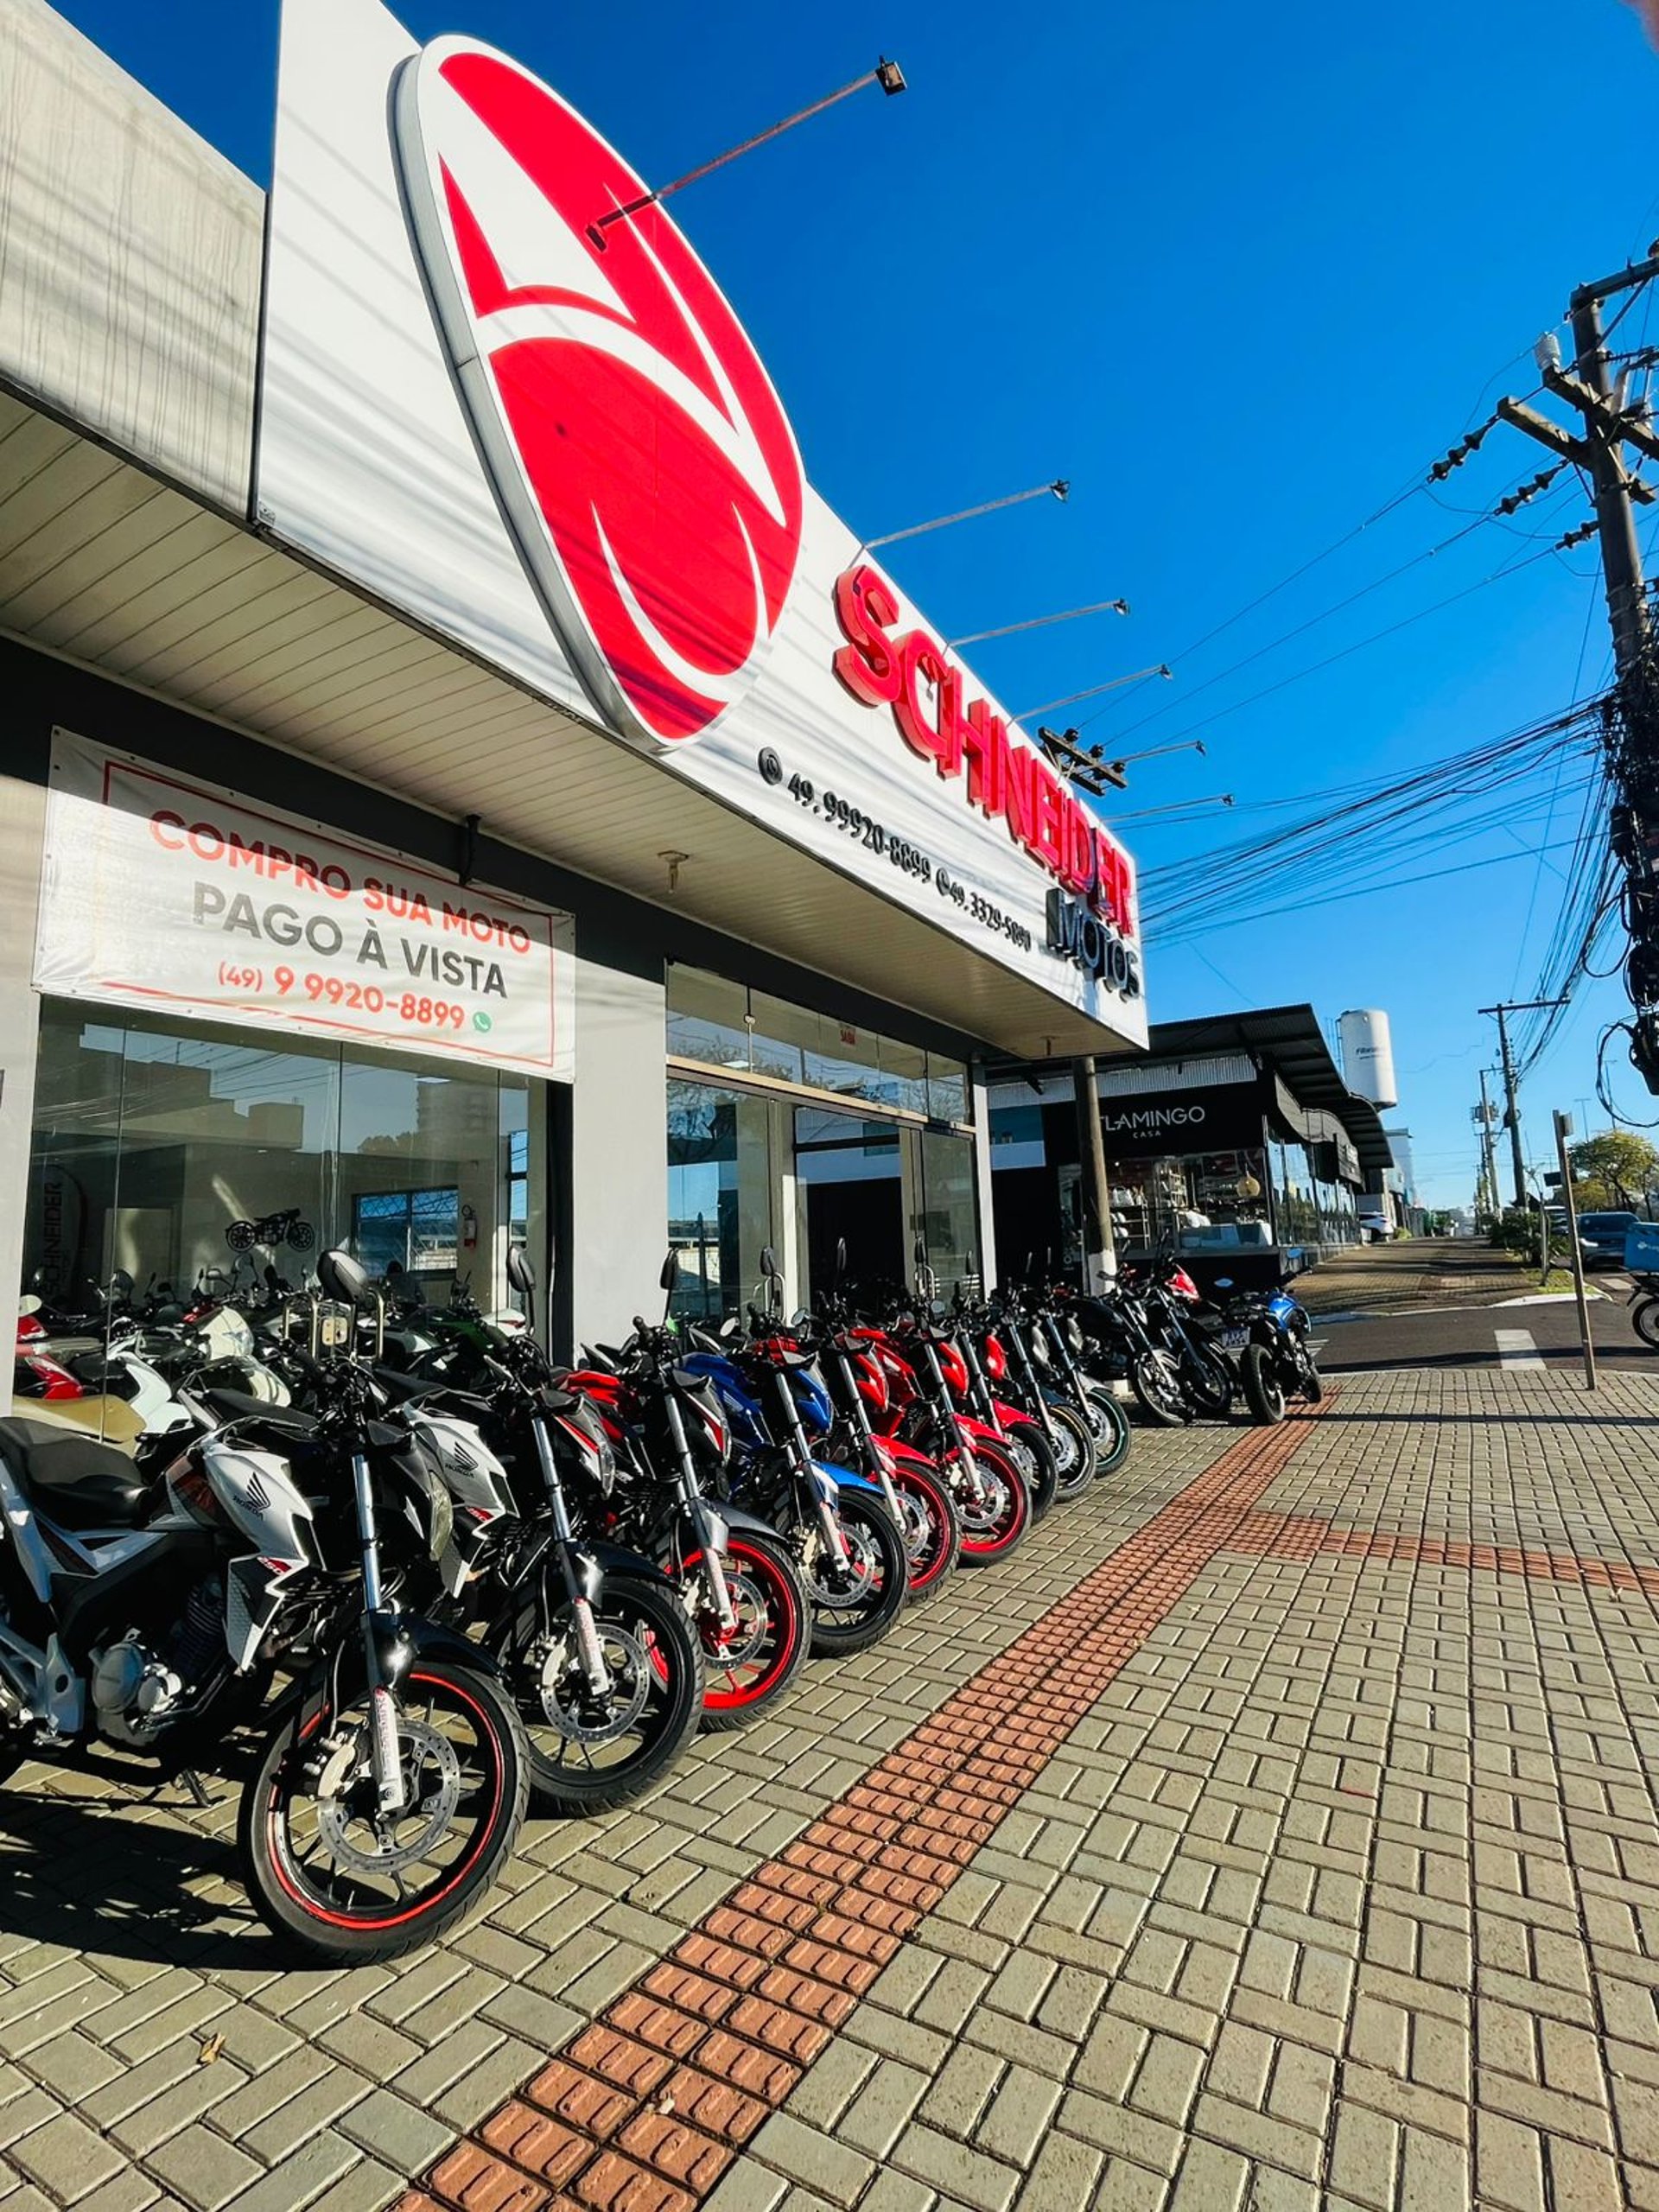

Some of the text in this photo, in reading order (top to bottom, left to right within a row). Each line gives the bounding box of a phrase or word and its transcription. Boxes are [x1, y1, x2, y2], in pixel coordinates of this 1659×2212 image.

[831, 564, 1135, 938] SCHNEIDER
[149, 810, 531, 954] COMPRO SUA MOTO
[192, 880, 508, 999] PAGO À VISTA
[218, 960, 465, 1030] (49) 9 9920-8899
[1046, 887, 1140, 1003] MOTOS
[1133, 1130, 1161, 1139] CASA
